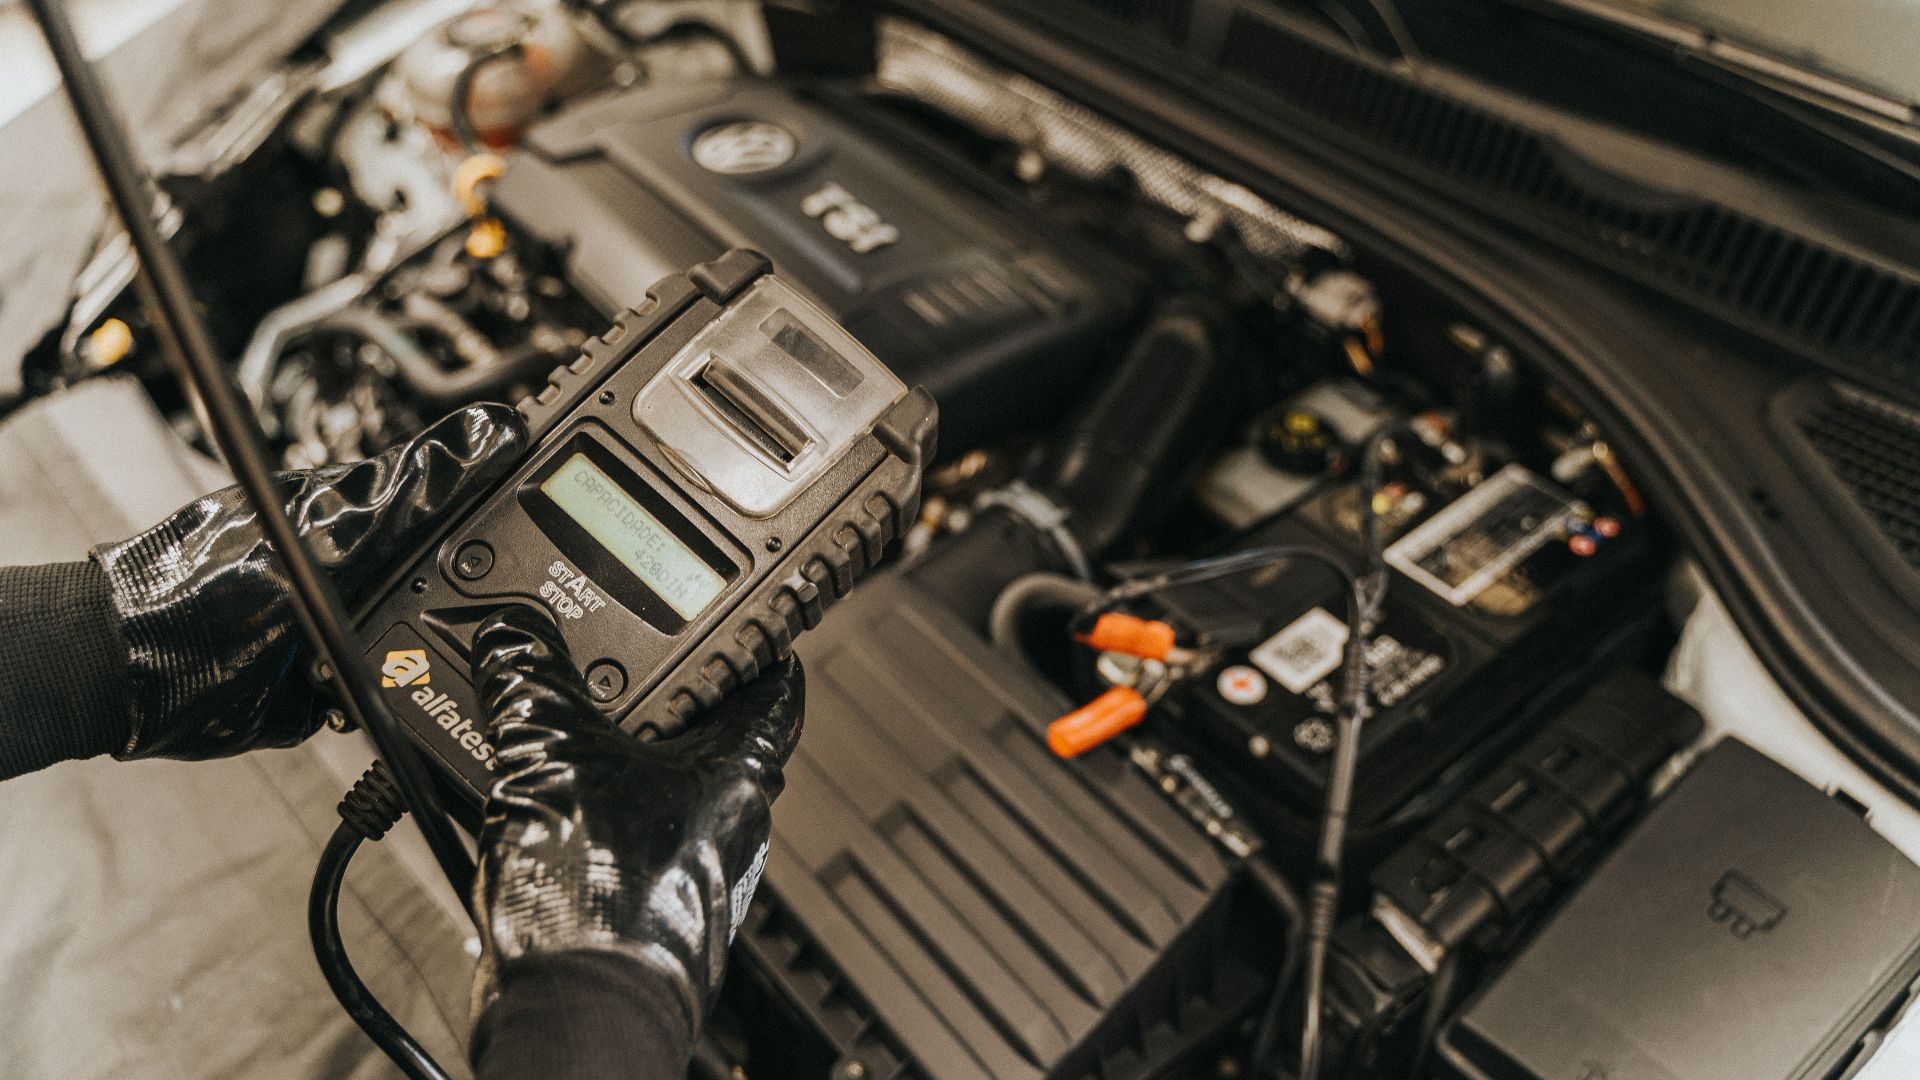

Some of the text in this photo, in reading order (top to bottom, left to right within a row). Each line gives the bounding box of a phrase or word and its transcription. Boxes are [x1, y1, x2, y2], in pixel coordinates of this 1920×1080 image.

[574, 469, 666, 553] CAPACIDADE:
[539, 580, 583, 619] STOP
[548, 560, 606, 612] START
